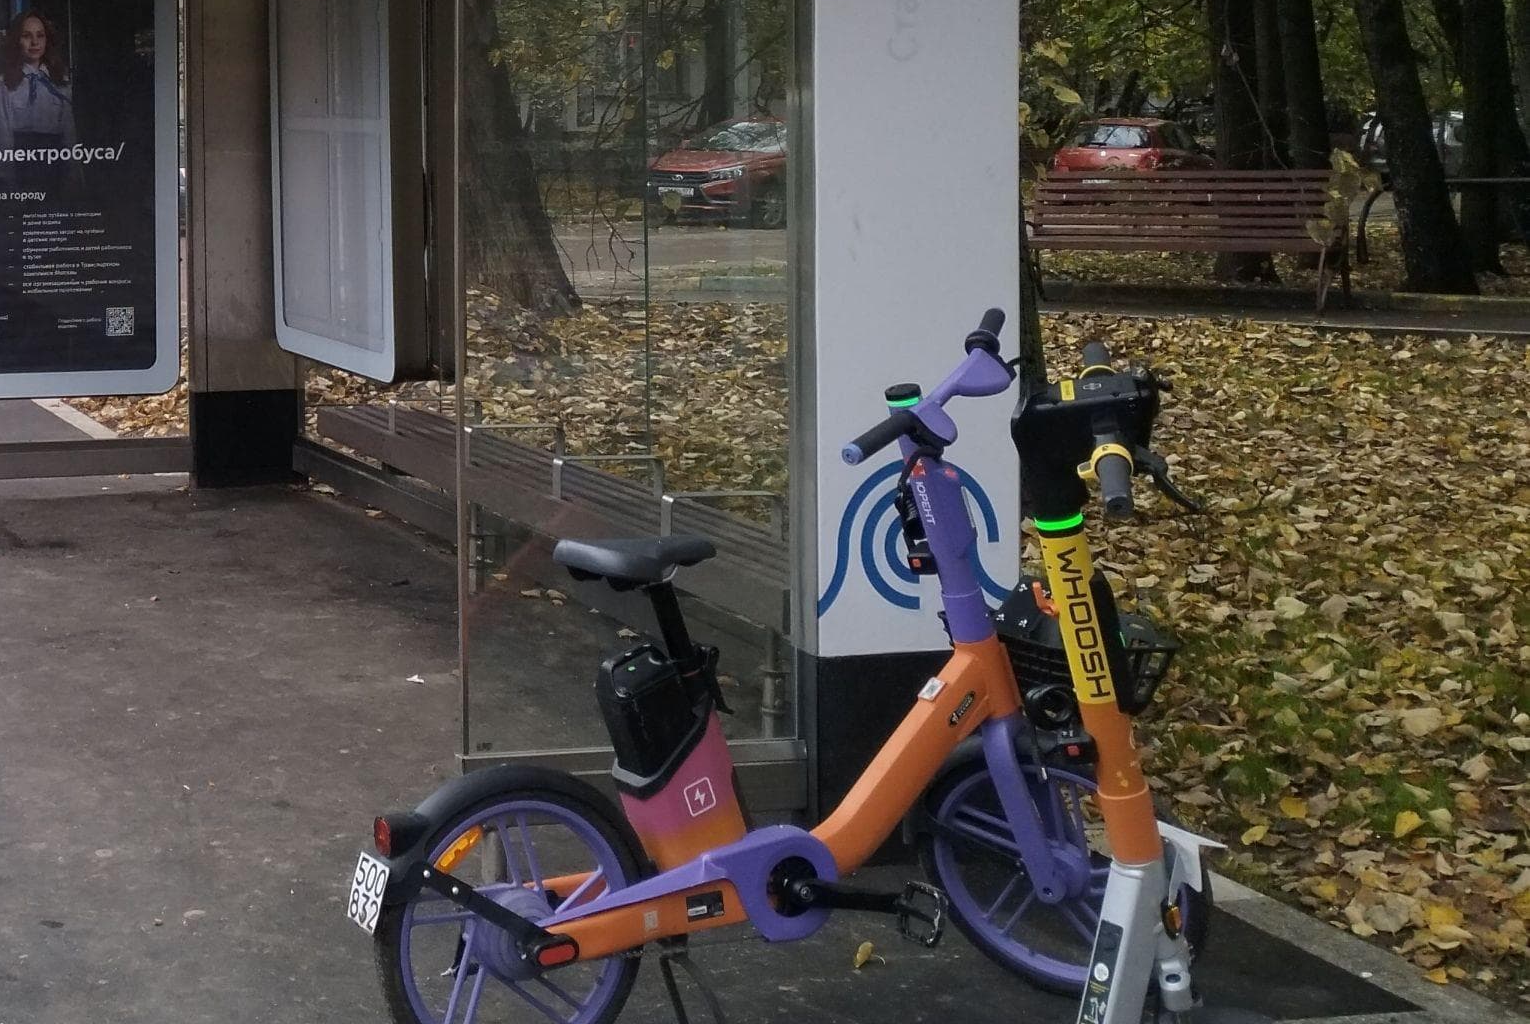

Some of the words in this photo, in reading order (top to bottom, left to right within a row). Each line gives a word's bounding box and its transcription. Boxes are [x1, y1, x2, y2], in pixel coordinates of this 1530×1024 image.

[10, 190, 47, 203] городу
[915, 481, 937, 526] ЮРЕНТ
[1056, 547, 1111, 700] WHOOSH
[355, 857, 387, 898] 500
[350, 888, 379, 931] 832
